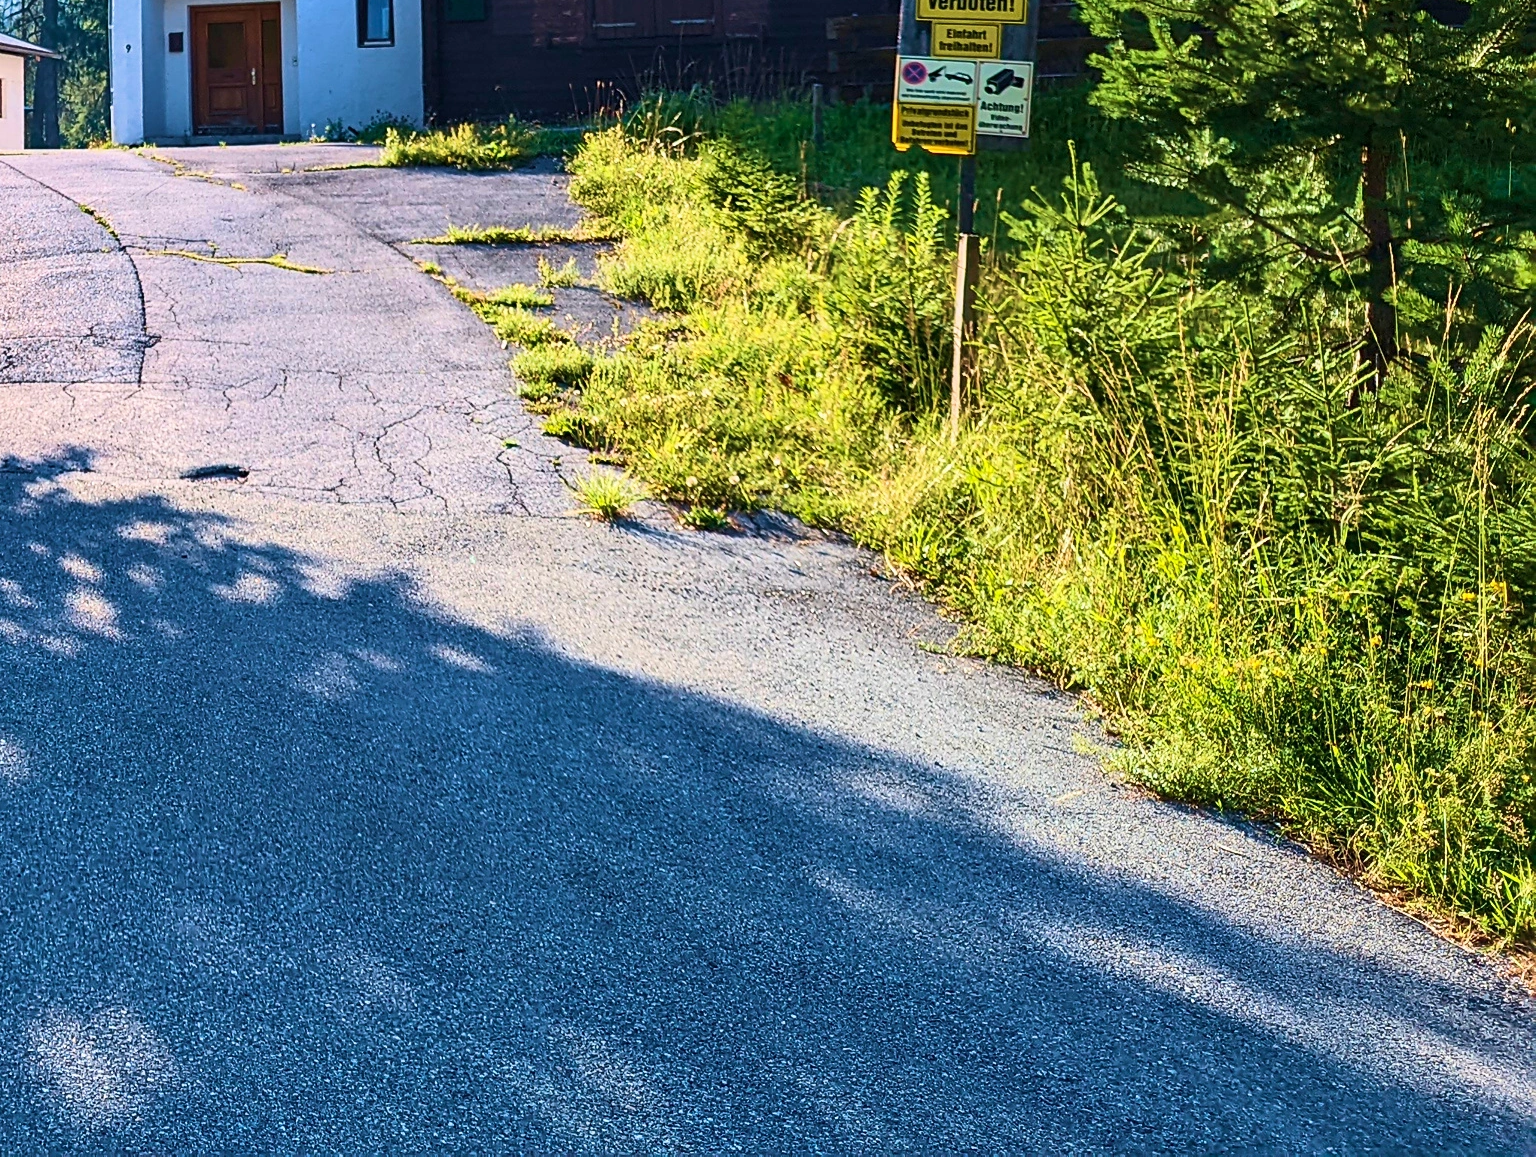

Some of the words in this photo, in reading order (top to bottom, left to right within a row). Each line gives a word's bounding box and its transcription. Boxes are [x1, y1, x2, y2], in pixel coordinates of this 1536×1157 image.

[946, 28, 987, 40] Einfahrt
[125, 43, 132, 53] 9
[938, 40, 993, 53] freihalten!
[980, 100, 1024, 114] Achtung!
